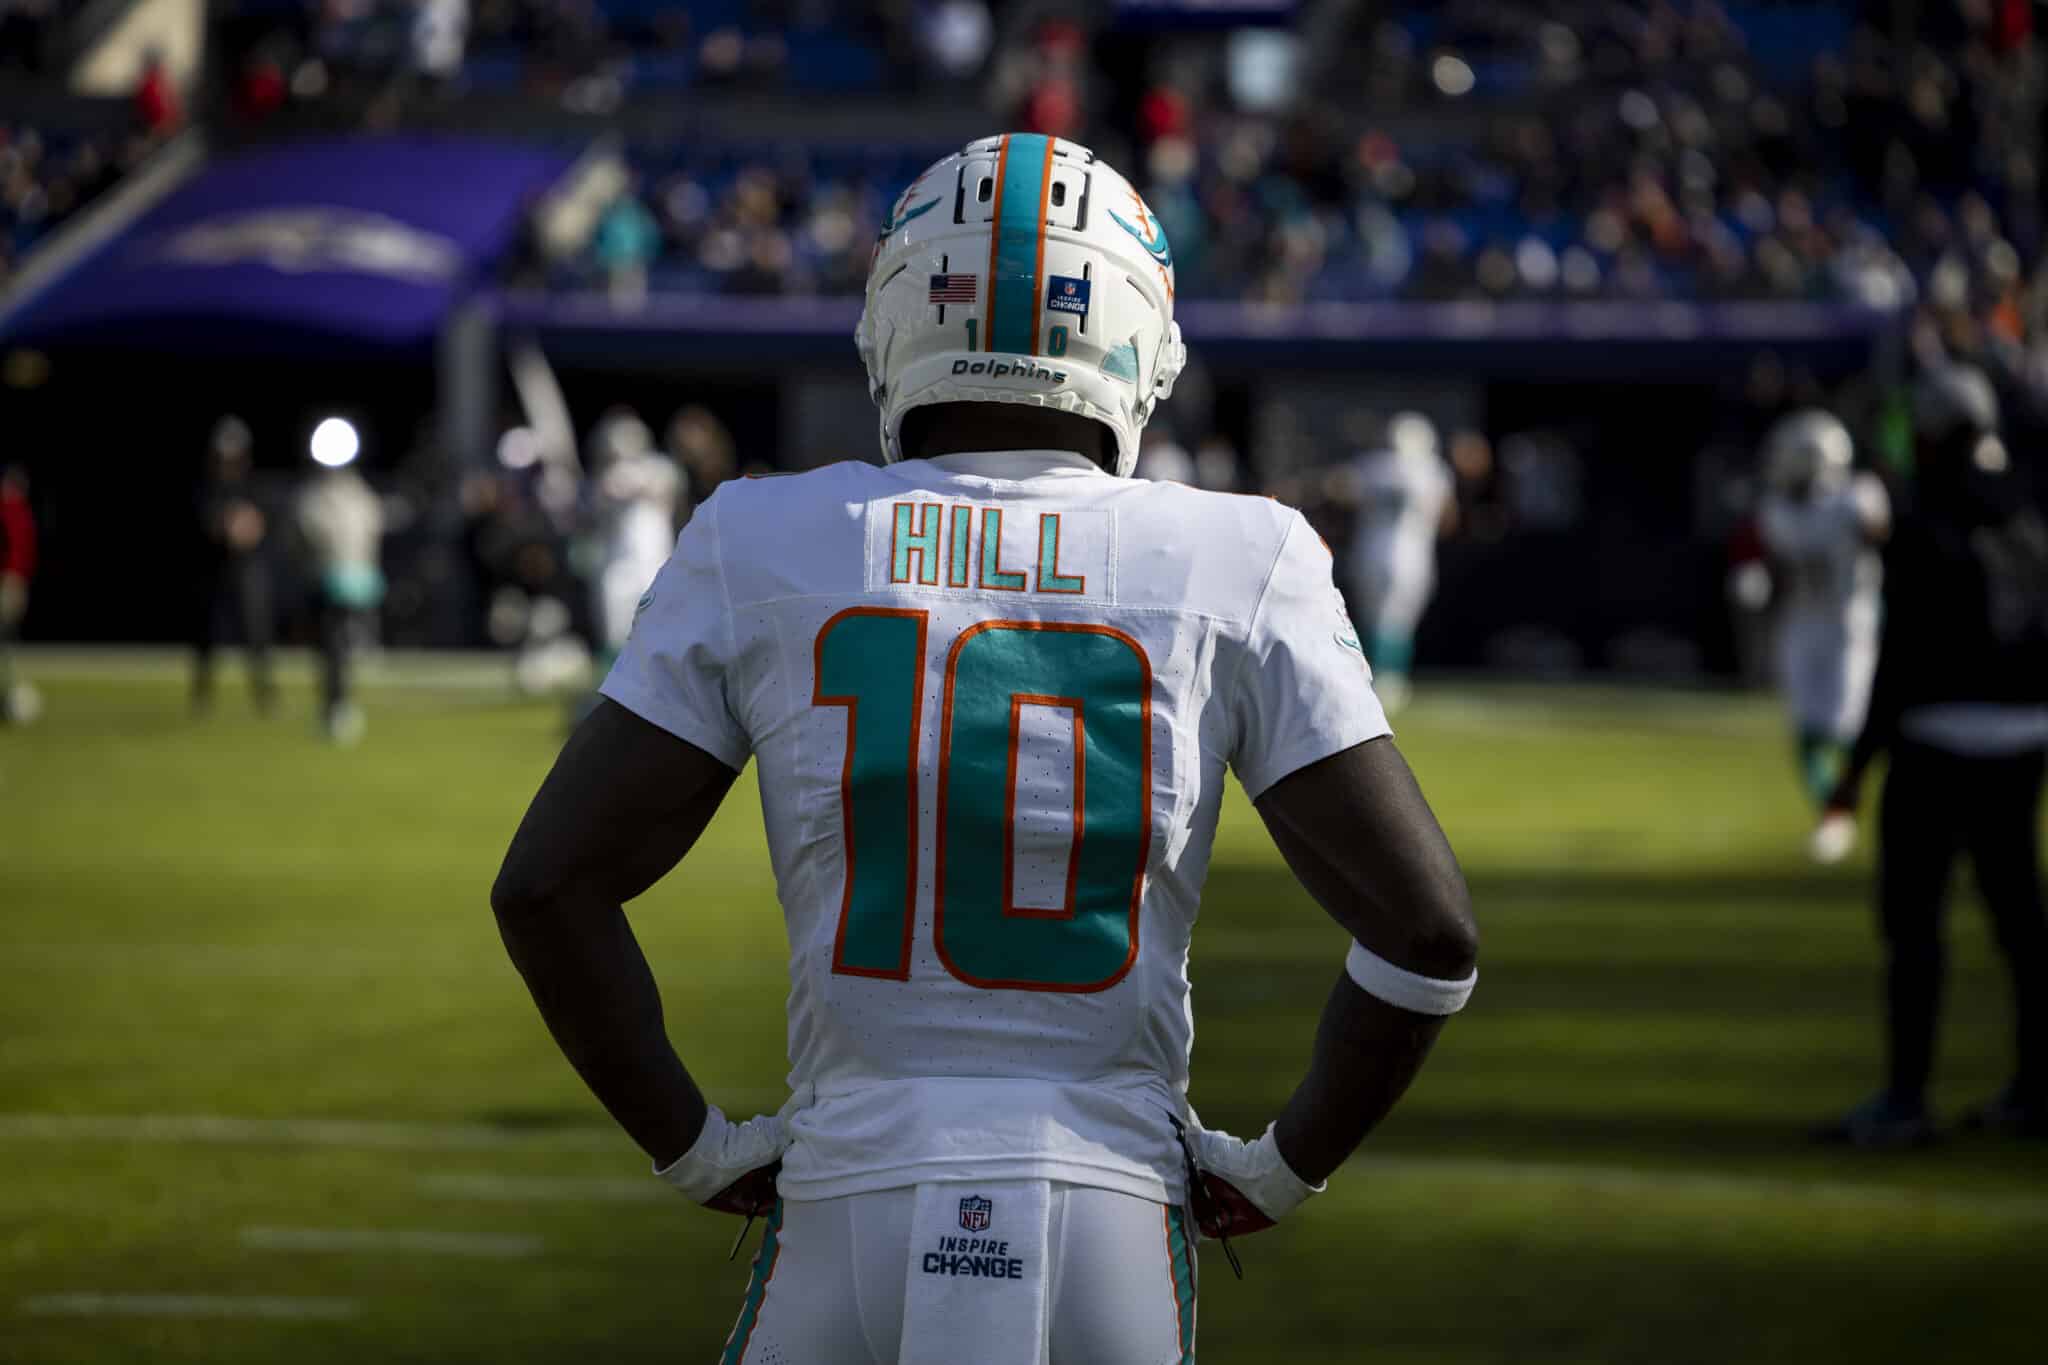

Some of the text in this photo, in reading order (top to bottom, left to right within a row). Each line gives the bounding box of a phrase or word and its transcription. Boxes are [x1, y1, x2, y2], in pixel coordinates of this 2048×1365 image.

[965, 318, 1068, 357] 1 0
[952, 359, 1068, 383] Dolphins
[890, 502, 1086, 594] HILL
[812, 606, 1152, 993] 10
[961, 1211, 988, 1229] NFL
[939, 1236, 1009, 1256] INSPIRE
[923, 1253, 1023, 1279] CHANGE
